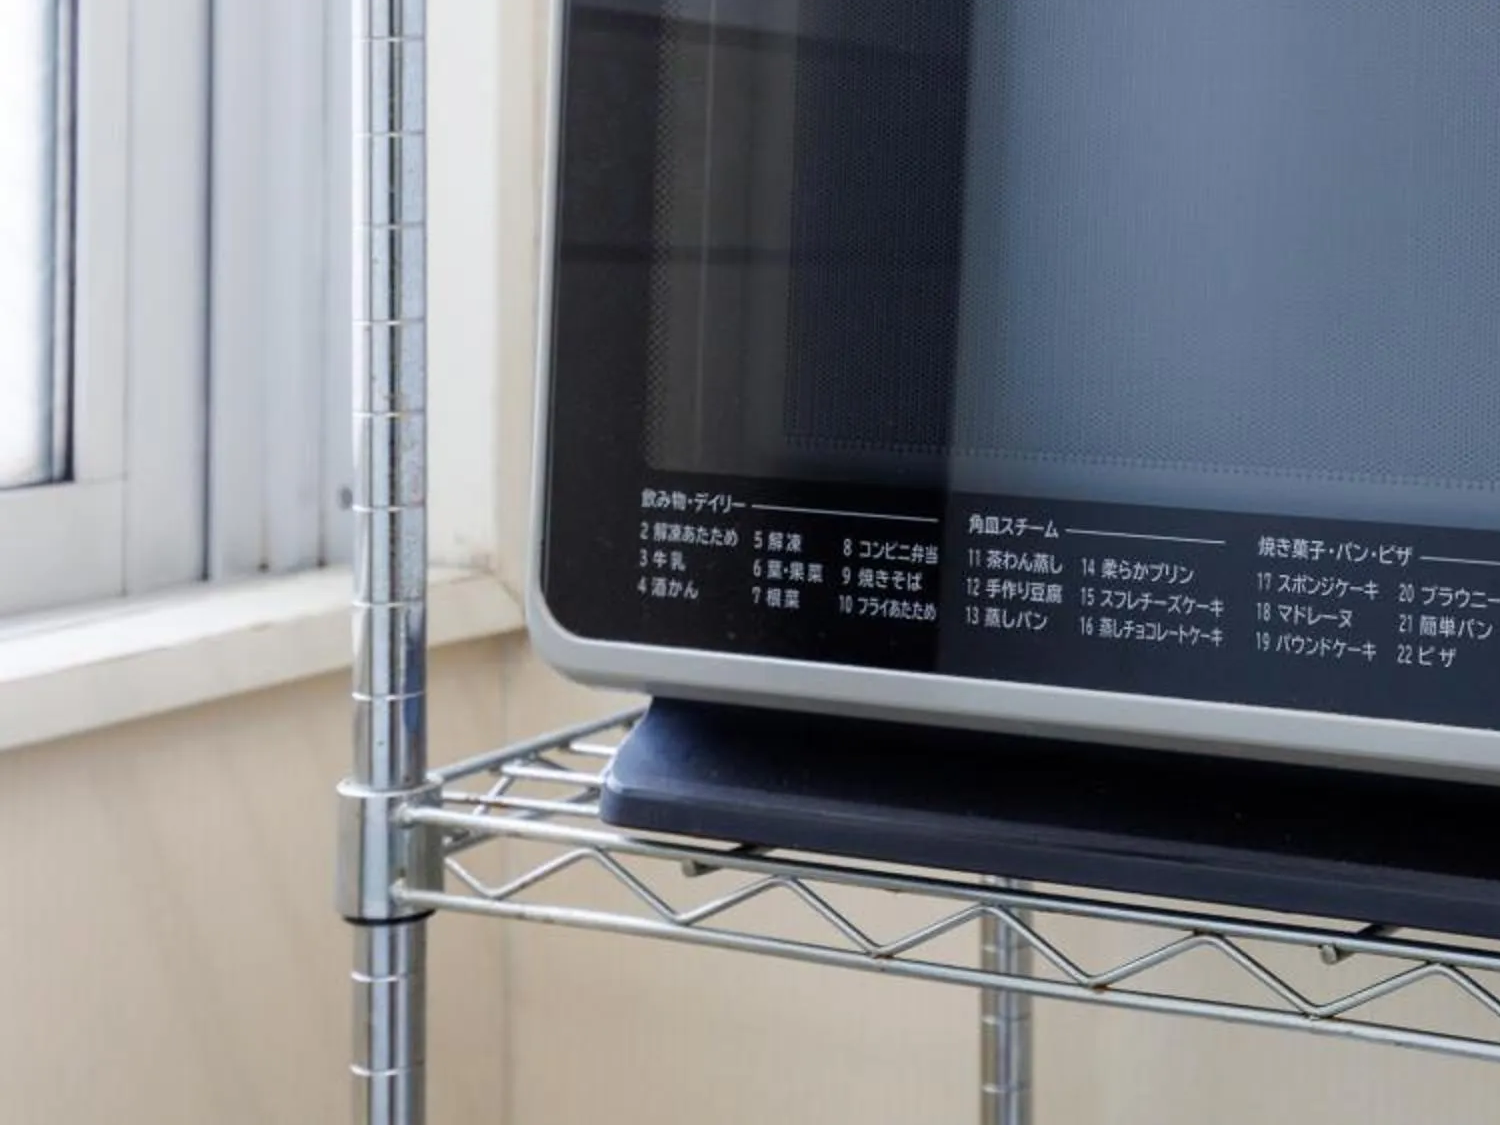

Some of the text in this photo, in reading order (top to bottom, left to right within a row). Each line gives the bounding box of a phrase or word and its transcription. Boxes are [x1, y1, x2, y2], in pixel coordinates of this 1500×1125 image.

[640, 523, 648, 540] 2
[969, 514, 1059, 539] 角皿スチーム
[753, 532, 763, 549] 5
[843, 539, 938, 565] 8 コンビニ弁当
[639, 550, 685, 571] 3 牛乳
[753, 560, 761, 578] 6
[968, 549, 1063, 574] 11 茶わん蒸し
[1082, 558, 1193, 583] 14 柔らかプリン
[637, 577, 699, 599] 4 酒かん
[842, 568, 922, 591] 9 焼きそば
[967, 578, 1062, 604] 12 手作り豆腐
[1256, 572, 1379, 599] 17 スポンジケーキ
[752, 587, 760, 604] 7
[1081, 587, 1224, 617] 15 スフレチーズケーキ
[1399, 584, 1414, 602] 20
[839, 595, 936, 621] 10 フライあたため
[966, 606, 1047, 630] 13 蒸しパン
[1256, 603, 1352, 627] 18 マドレーヌ
[1081, 617, 1223, 647] 16 蒸しチョコレートケーキ
[1400, 615, 1492, 639] 21 簡単パン
[1256, 632, 1376, 661] 19 パウンドケーキ
[1397, 645, 1456, 667] 22 ピザ
